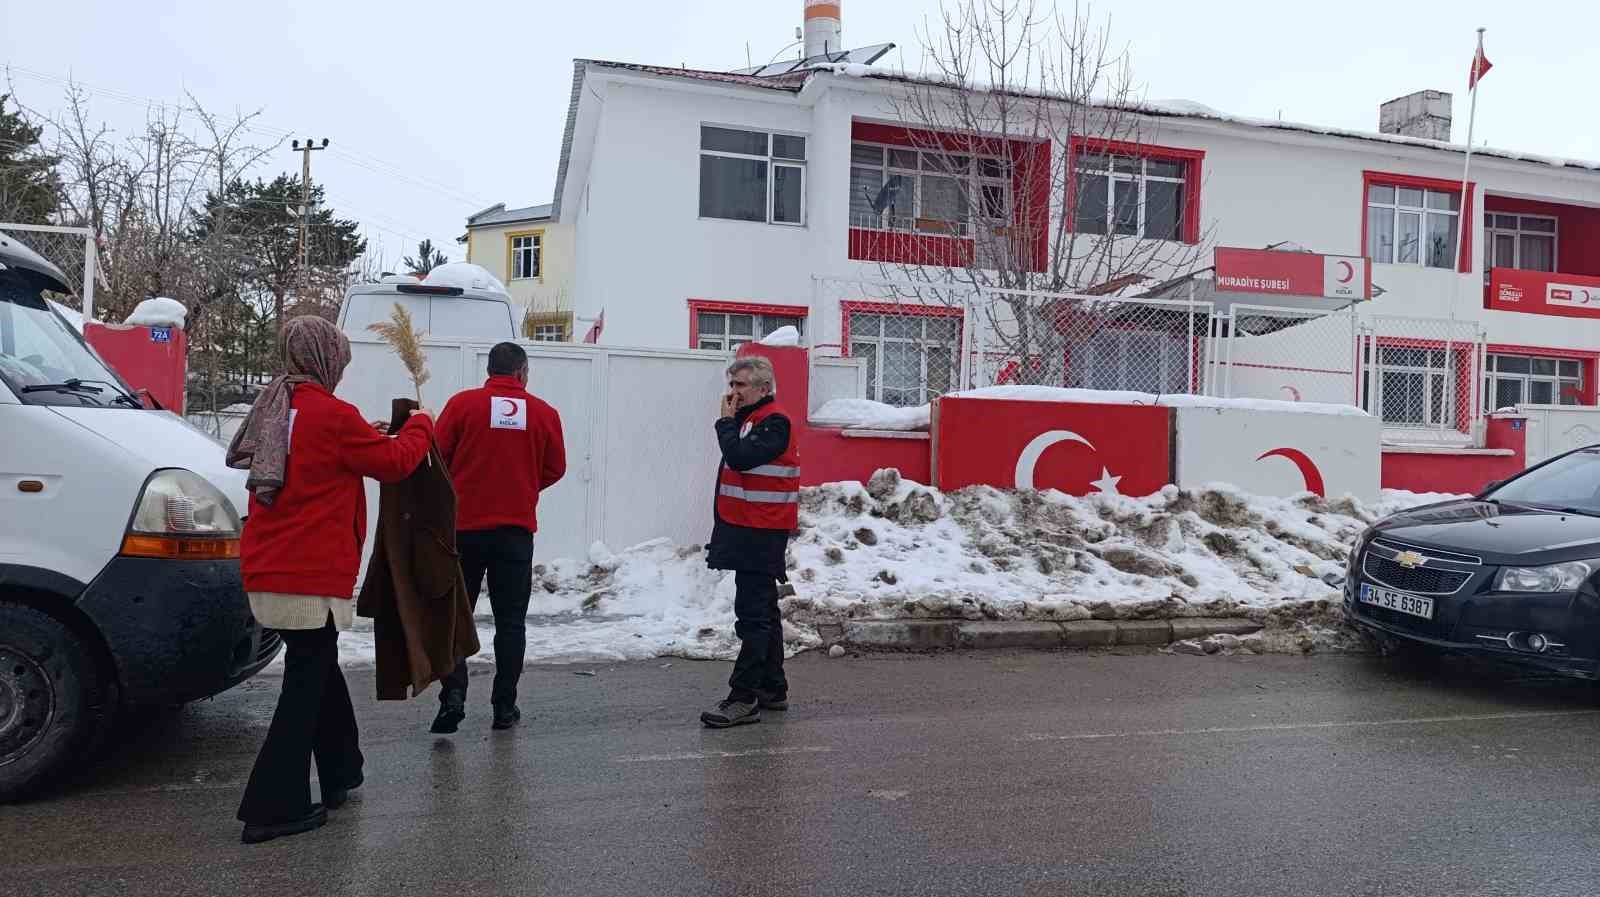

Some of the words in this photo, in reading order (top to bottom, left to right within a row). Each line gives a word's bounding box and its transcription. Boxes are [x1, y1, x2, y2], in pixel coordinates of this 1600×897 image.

[1217, 276, 1260, 289] MURADİYE
[1368, 588, 1380, 604] 34
[1385, 592, 1398, 609] SE
[1401, 597, 1430, 616] 6387
